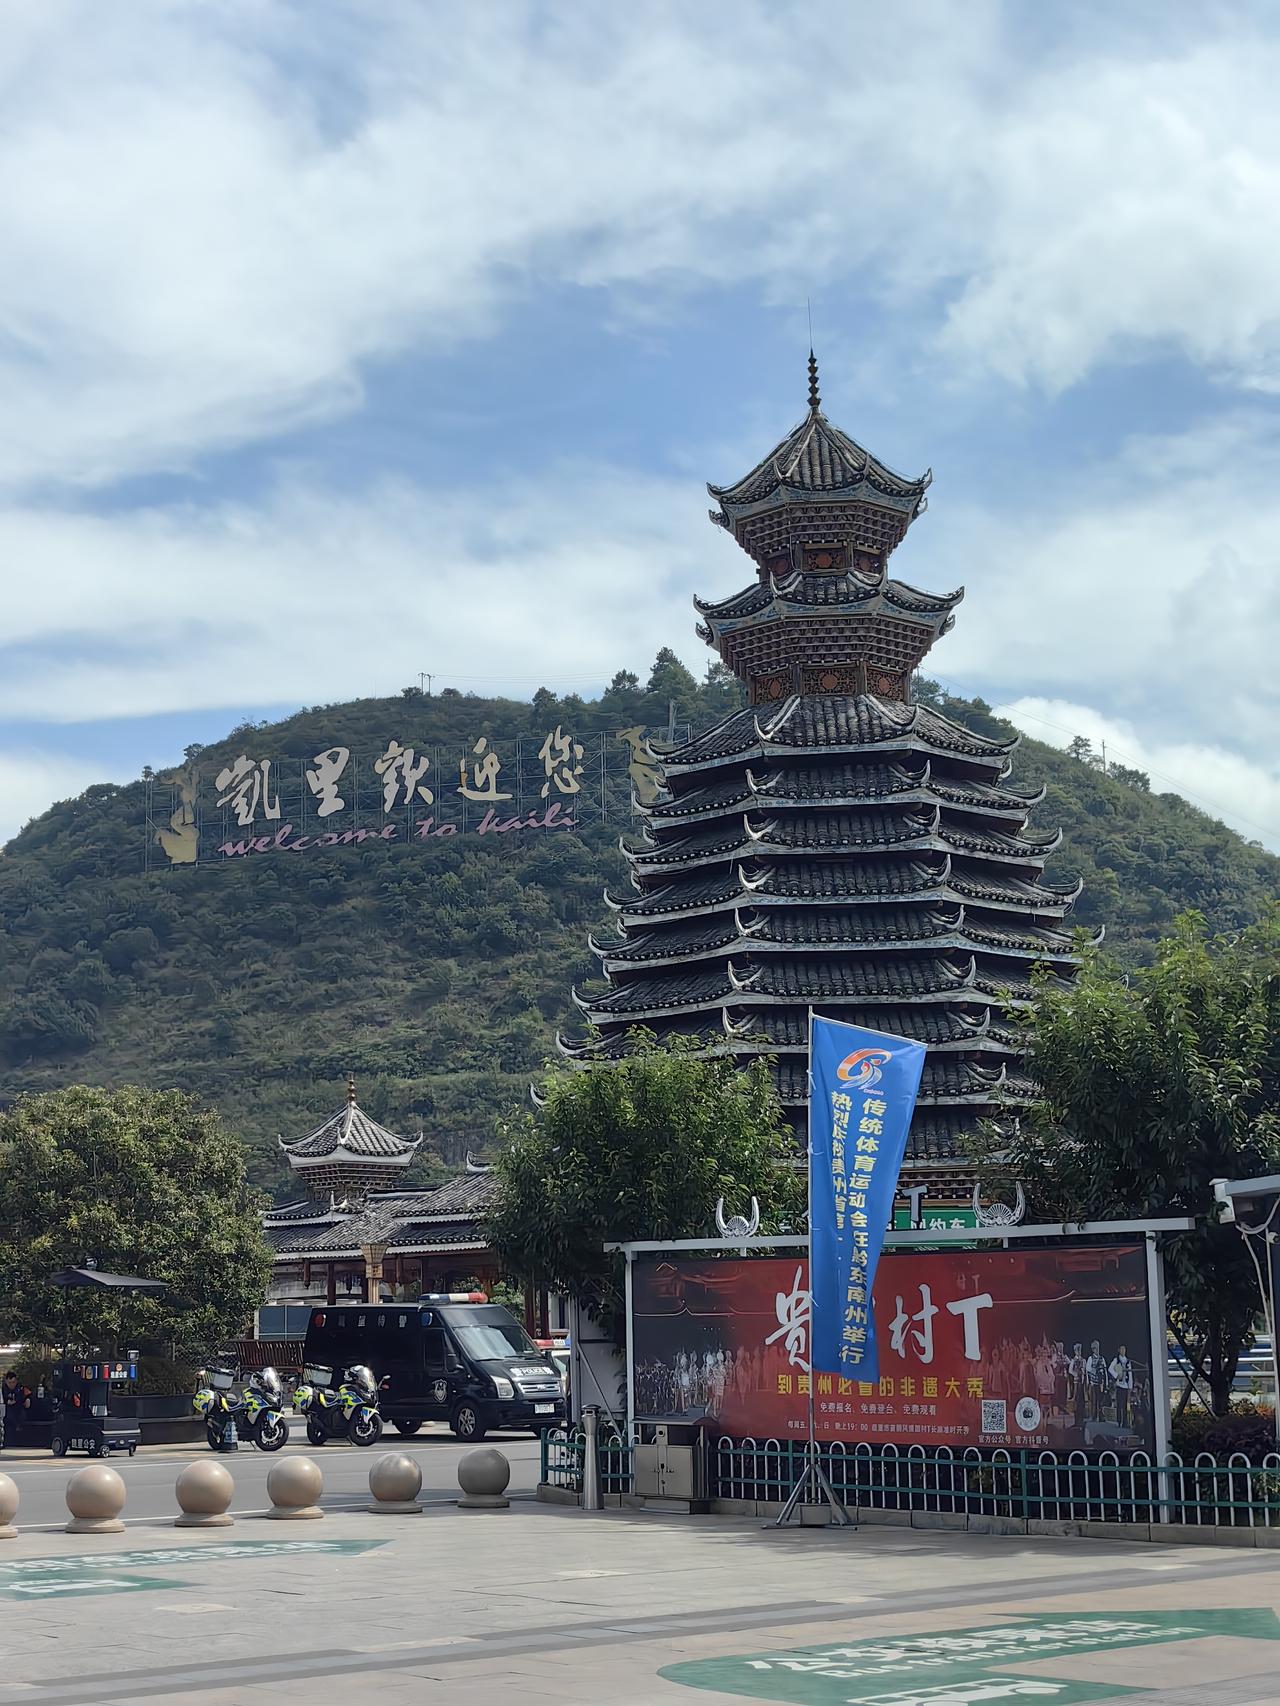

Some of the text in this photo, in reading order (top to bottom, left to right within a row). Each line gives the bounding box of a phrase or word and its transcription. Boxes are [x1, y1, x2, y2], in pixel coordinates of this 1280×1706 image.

[217, 824, 398, 857] welcome
[414, 816, 458, 839] to
[765, 1265, 993, 1372] 贵村T
[978, 1434, 1012, 1444] 官方公众号
[813, 1626, 1207, 1677] Bus transfer station
